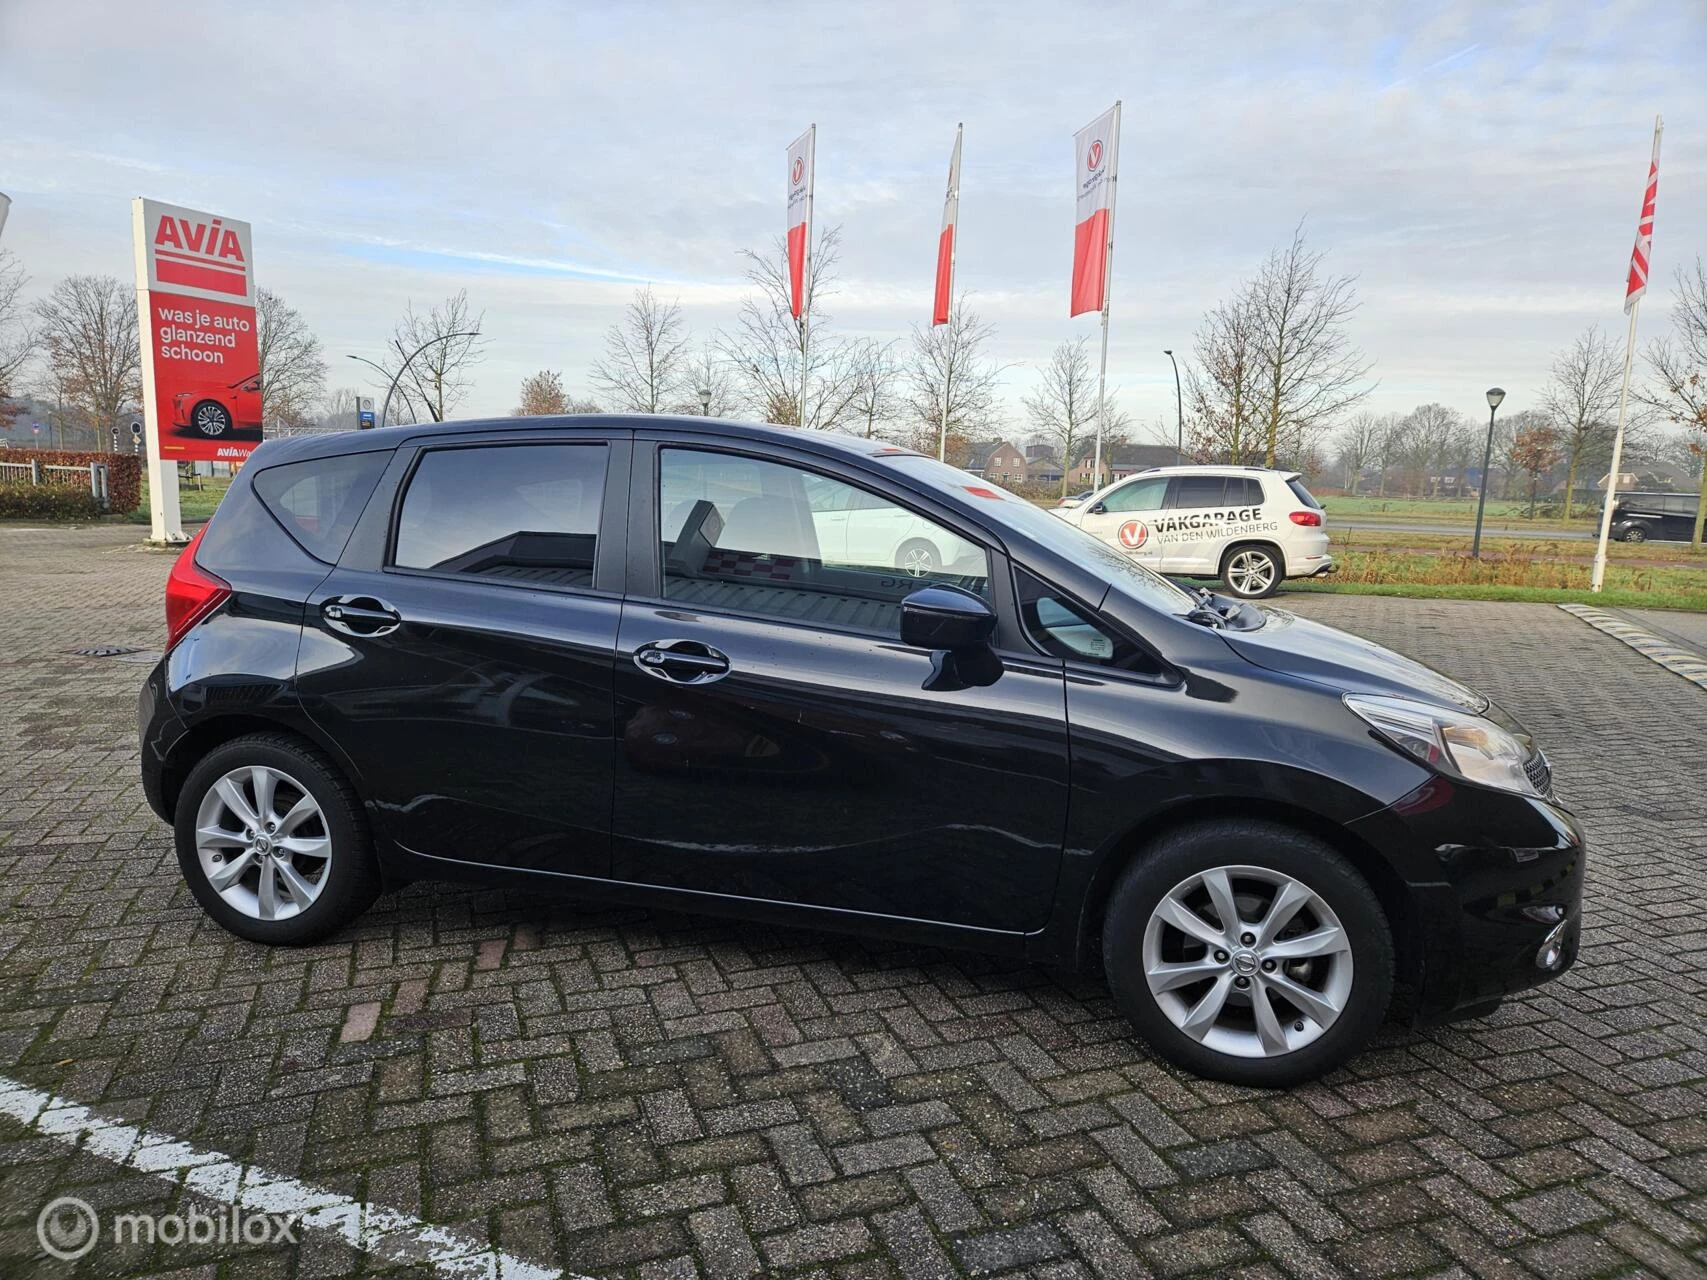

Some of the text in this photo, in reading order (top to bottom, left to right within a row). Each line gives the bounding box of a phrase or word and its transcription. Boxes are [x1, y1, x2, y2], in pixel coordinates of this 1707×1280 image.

[158, 307, 250, 332] was je auto
[160, 324, 236, 348] glanzend
[161, 344, 224, 365] schoon
[1157, 521, 1278, 545] VAN DEN WILDENBERG
